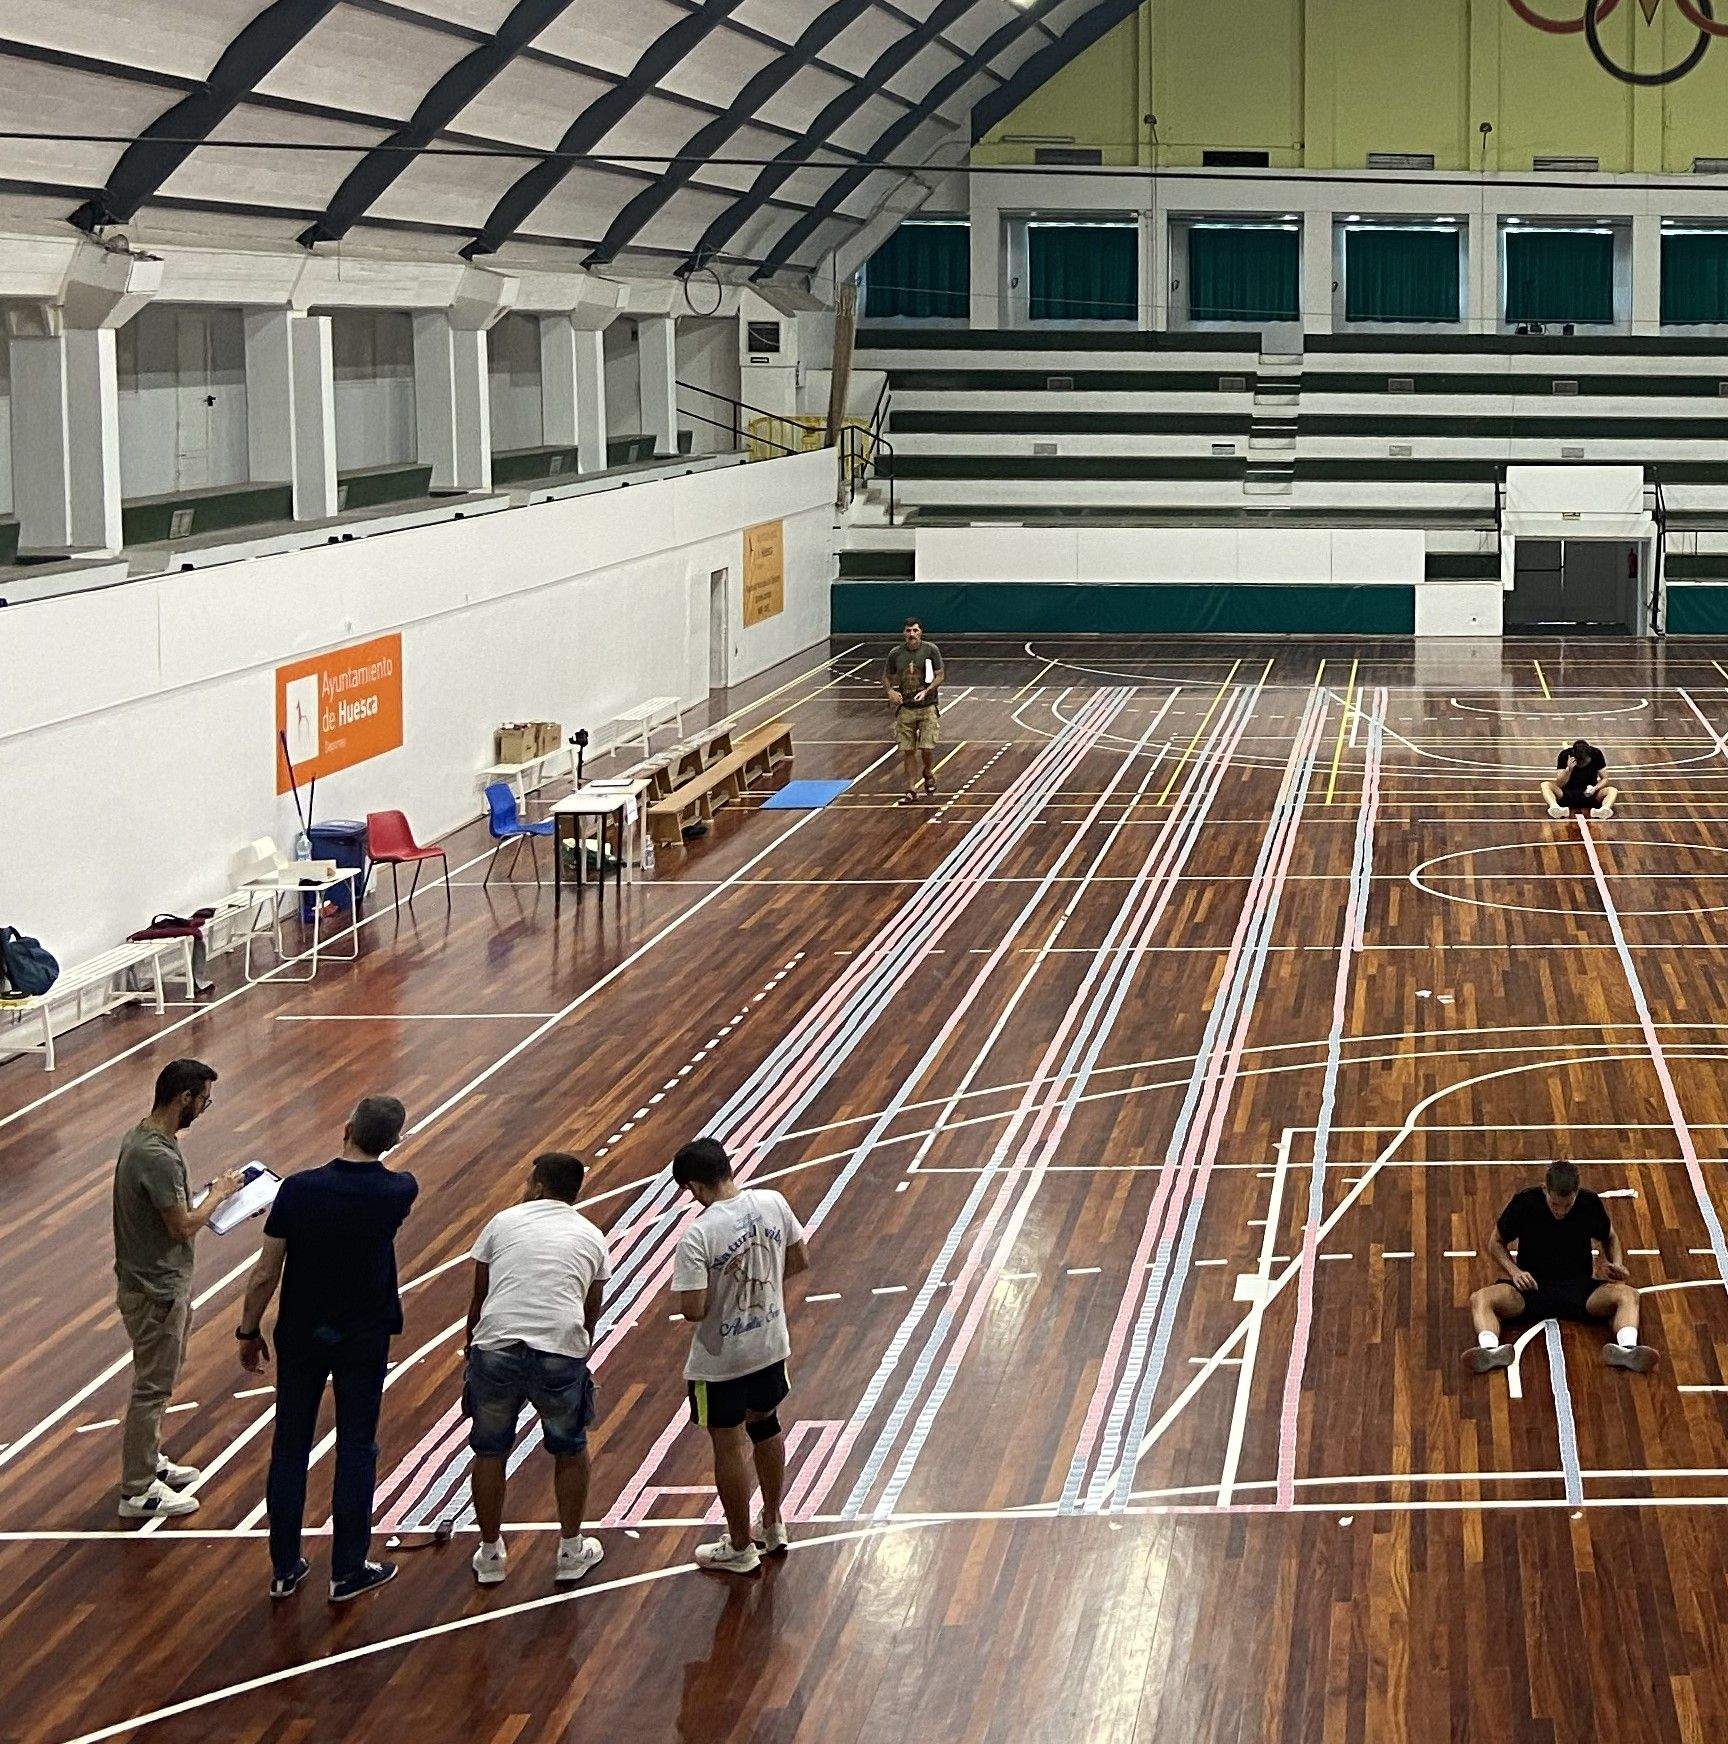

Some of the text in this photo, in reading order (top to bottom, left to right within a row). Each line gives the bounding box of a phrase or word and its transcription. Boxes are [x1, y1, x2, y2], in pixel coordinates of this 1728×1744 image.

[322, 656, 393, 702] Ayuntamiento
[322, 695, 379, 733] de Huesca
